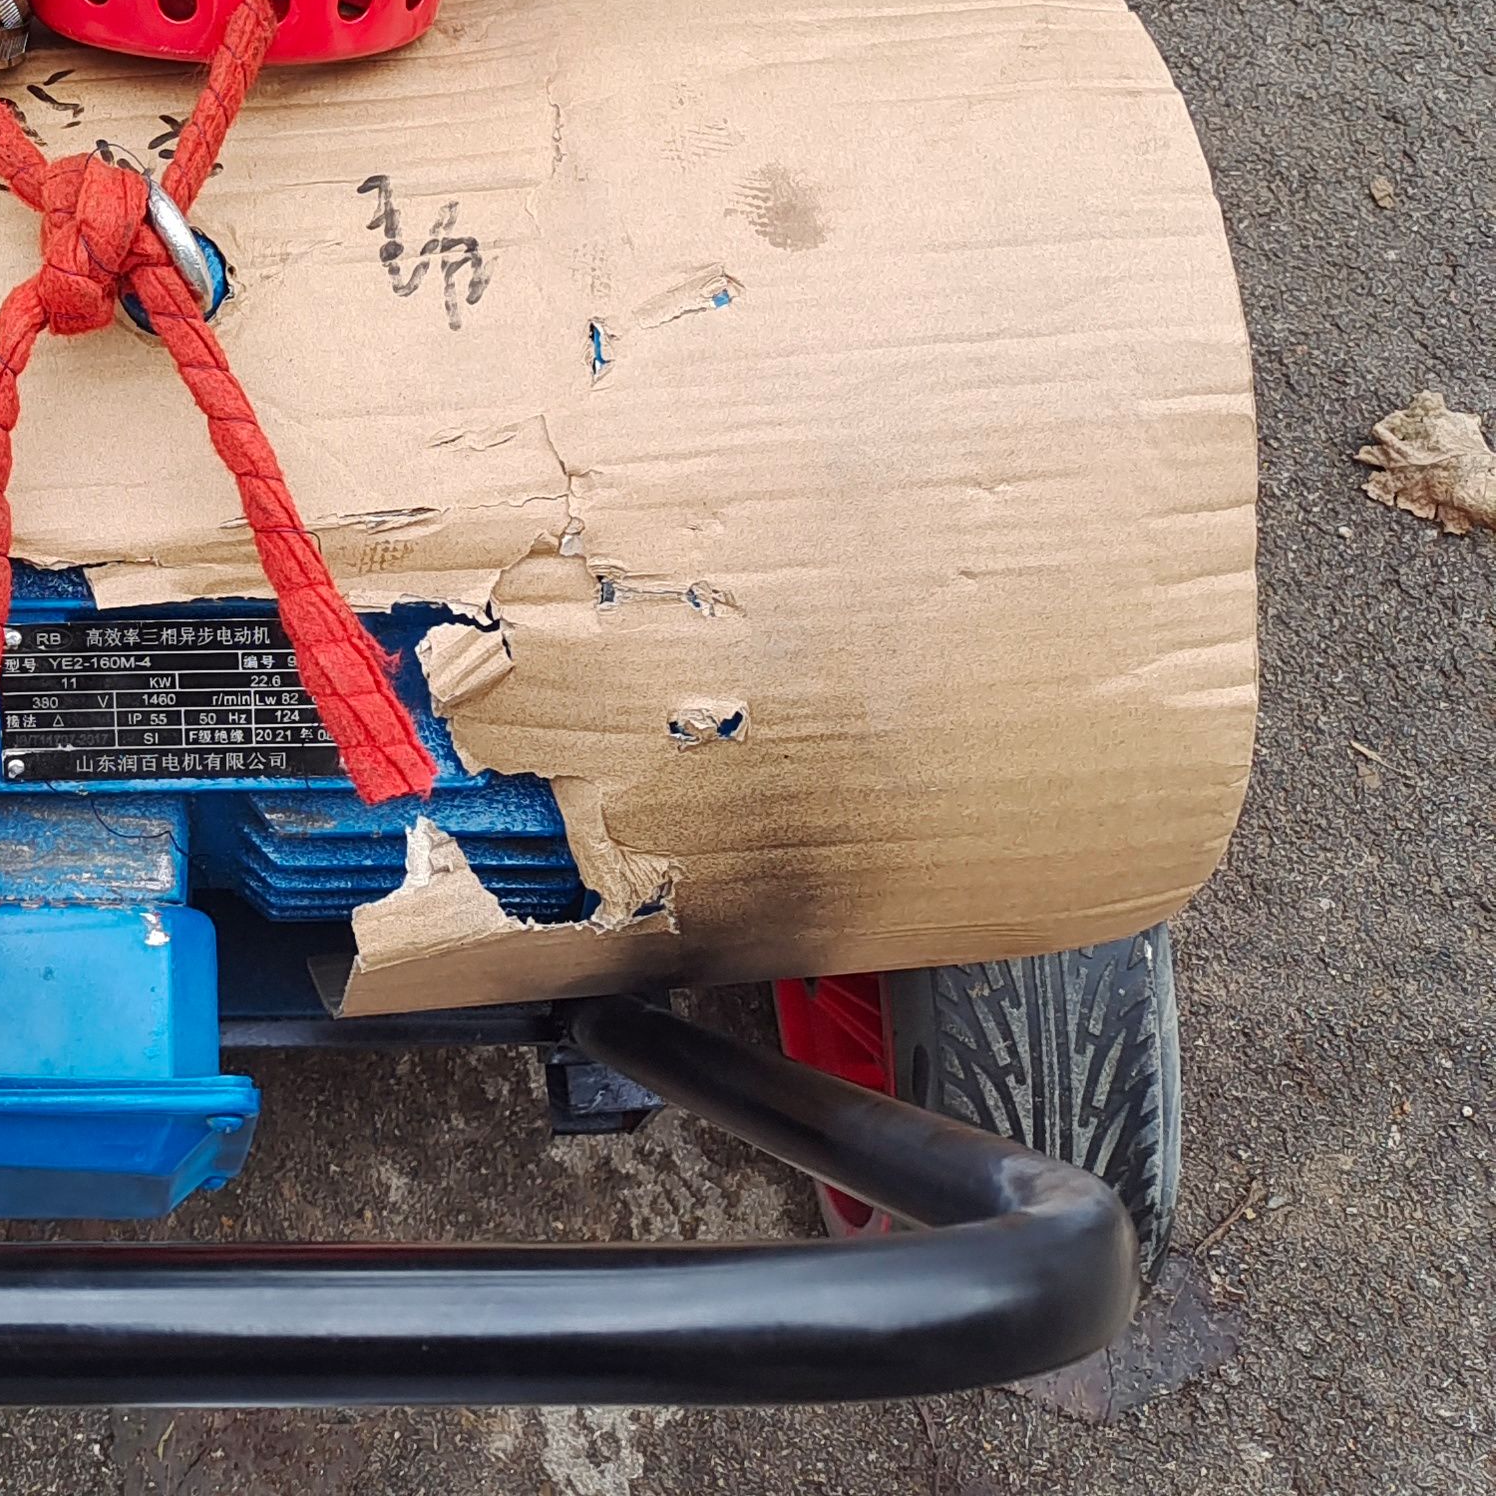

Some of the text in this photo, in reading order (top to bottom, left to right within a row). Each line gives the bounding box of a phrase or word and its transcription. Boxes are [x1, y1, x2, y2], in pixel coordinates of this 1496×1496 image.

[36, 633, 61, 646] RB
[86, 626, 271, 647] 高效率三相异步电动机
[4, 657, 152, 673] 型号 YE2-160M-4
[243, 655, 275, 669] 编号
[61, 677, 172, 689] 11 KW
[250, 675, 281, 687] 22.6
[98, 696, 109, 708] V
[142, 693, 251, 706] 1460 r/min
[281, 693, 299, 705] 82
[6, 714, 37, 728] 接法
[128, 713, 167, 725] IP 55
[199, 712, 247, 724] 50 Hz
[275, 710, 300, 722] 124
[189, 729, 245, 744] F级绝缘
[76, 751, 287, 773] 山东润百电机有限公司
